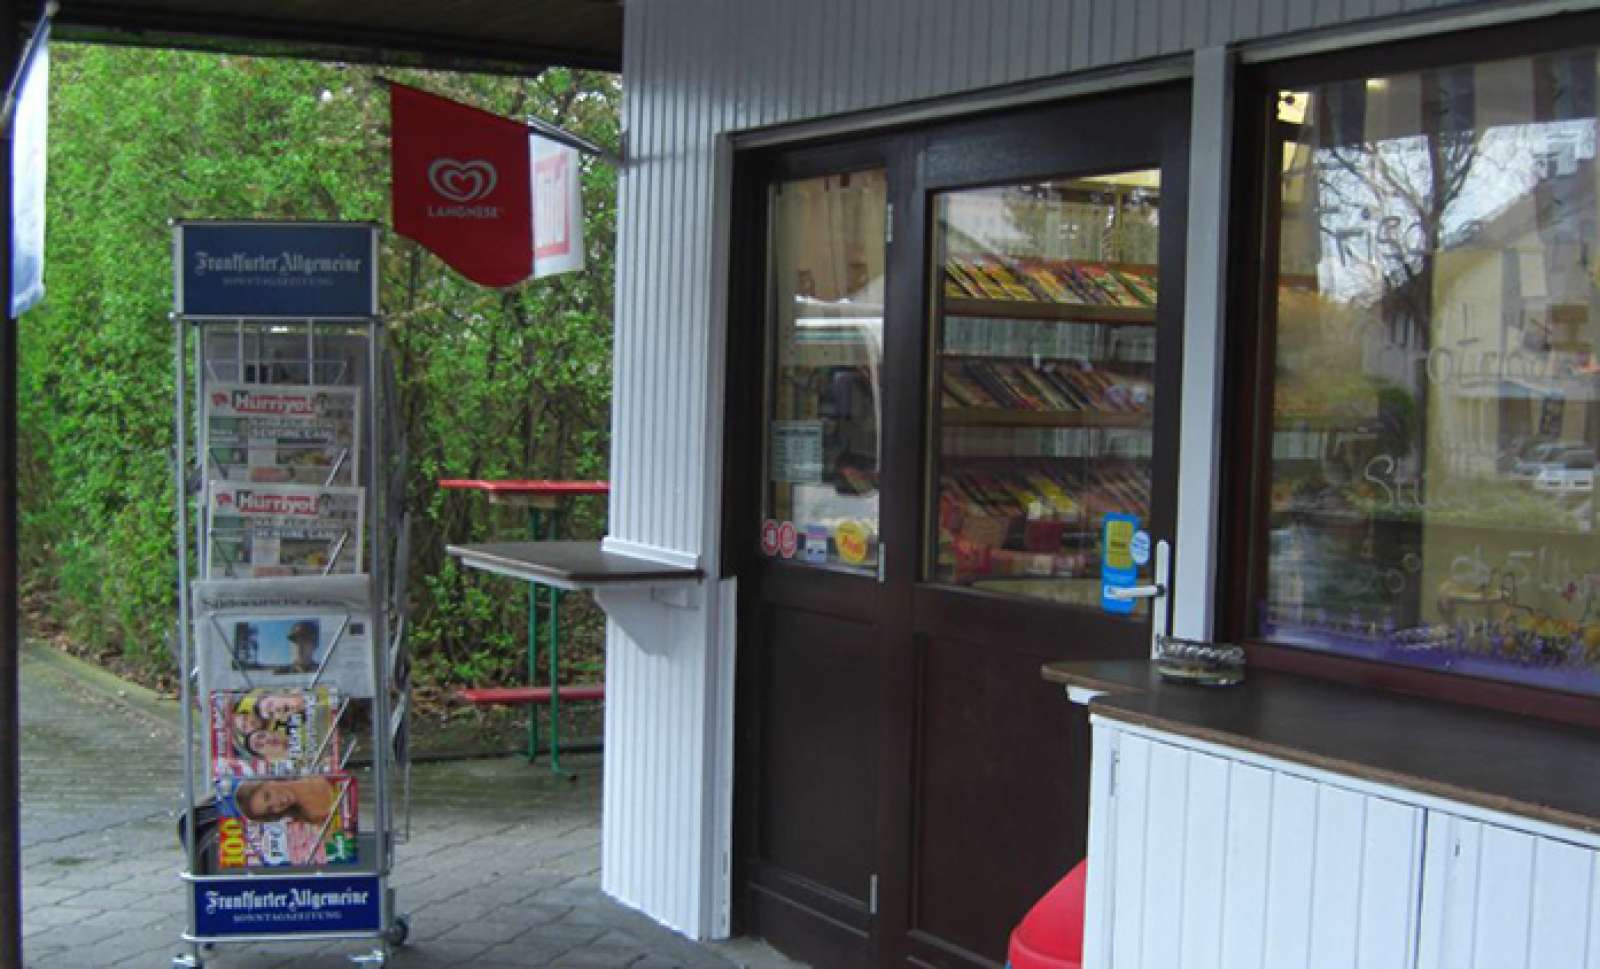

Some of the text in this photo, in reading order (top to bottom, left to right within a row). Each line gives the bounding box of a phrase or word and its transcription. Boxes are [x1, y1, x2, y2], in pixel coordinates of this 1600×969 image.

[427, 206, 497, 218] LANGNESE
[194, 251, 362, 276] Frankfurter Allgemeine
[221, 818, 246, 867] 100
[204, 887, 369, 914] Frankfurter Allgemeine
